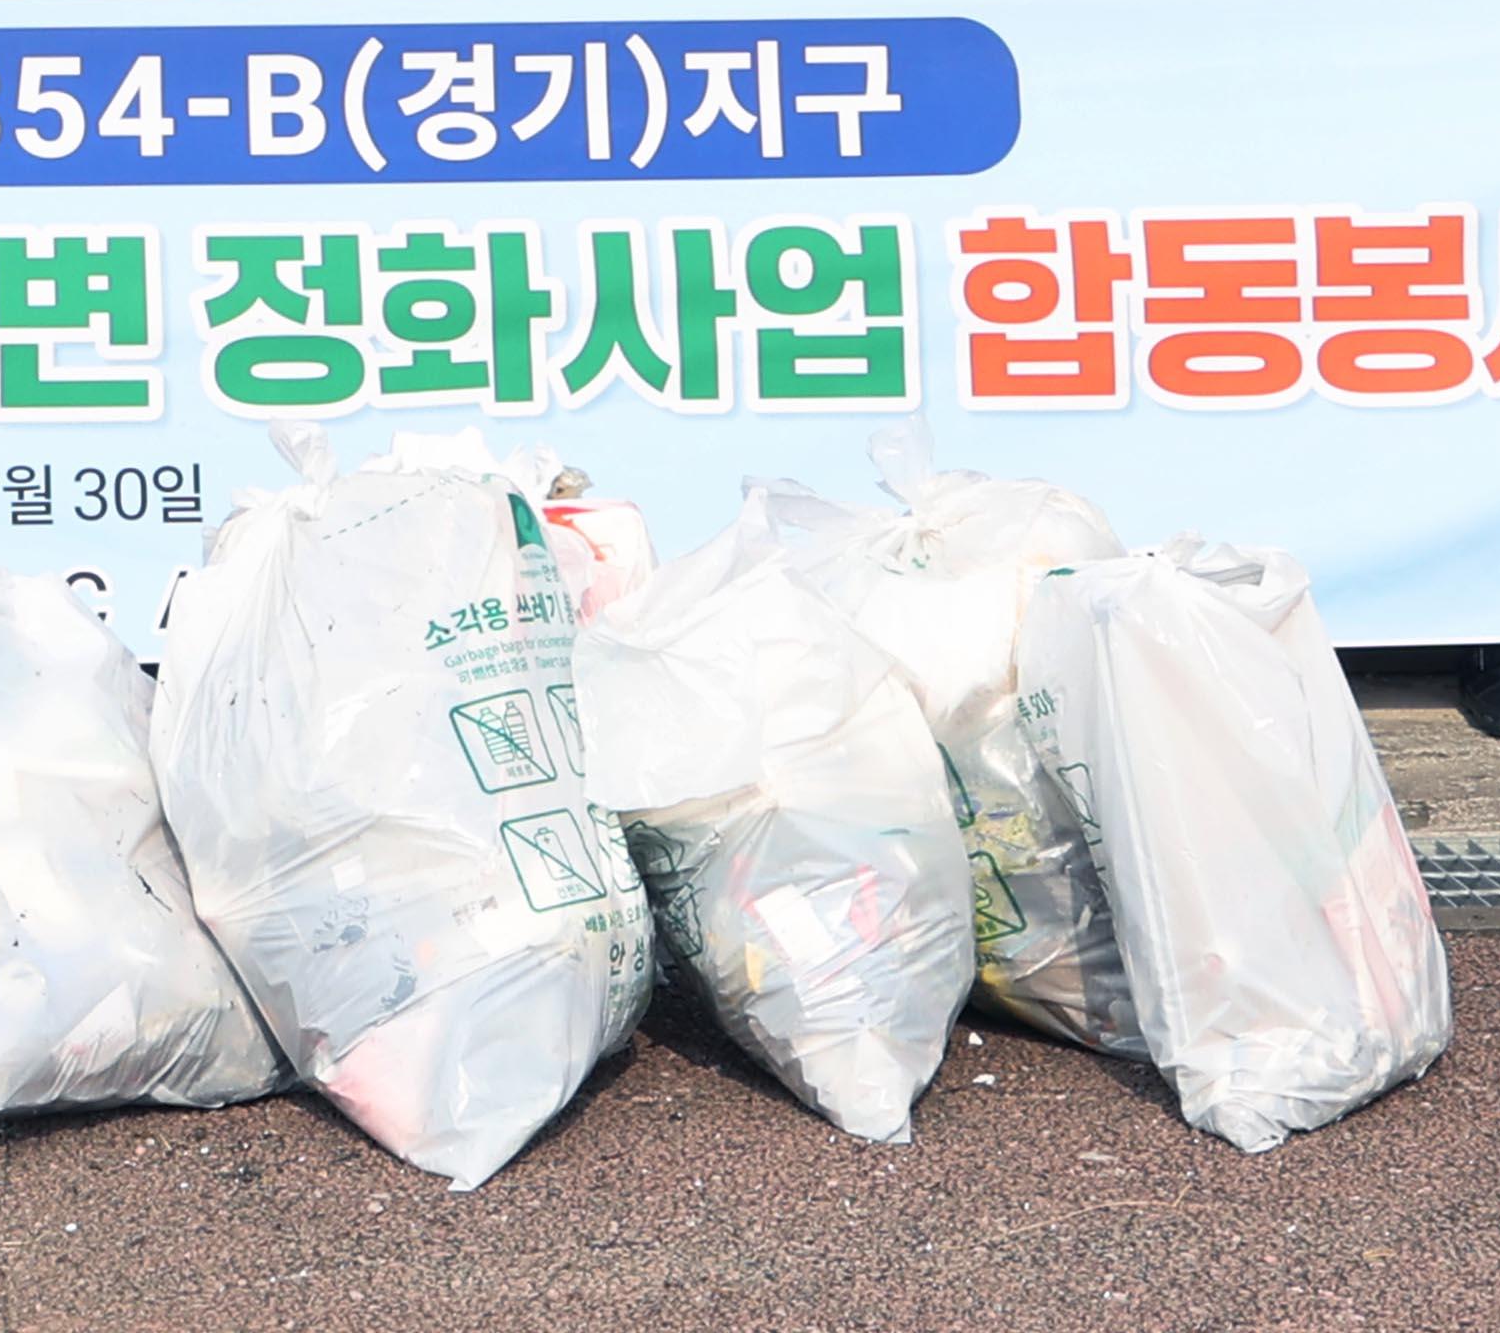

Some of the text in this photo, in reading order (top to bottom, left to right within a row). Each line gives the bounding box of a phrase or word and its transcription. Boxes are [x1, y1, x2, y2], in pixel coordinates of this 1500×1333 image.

[204, 225, 906, 406] 정화사업
[74, 463, 204, 523] 30일
[424, 597, 509, 651] 소각용
[516, 590, 564, 625] 쓰레기
[444, 644, 500, 669] Garbage
